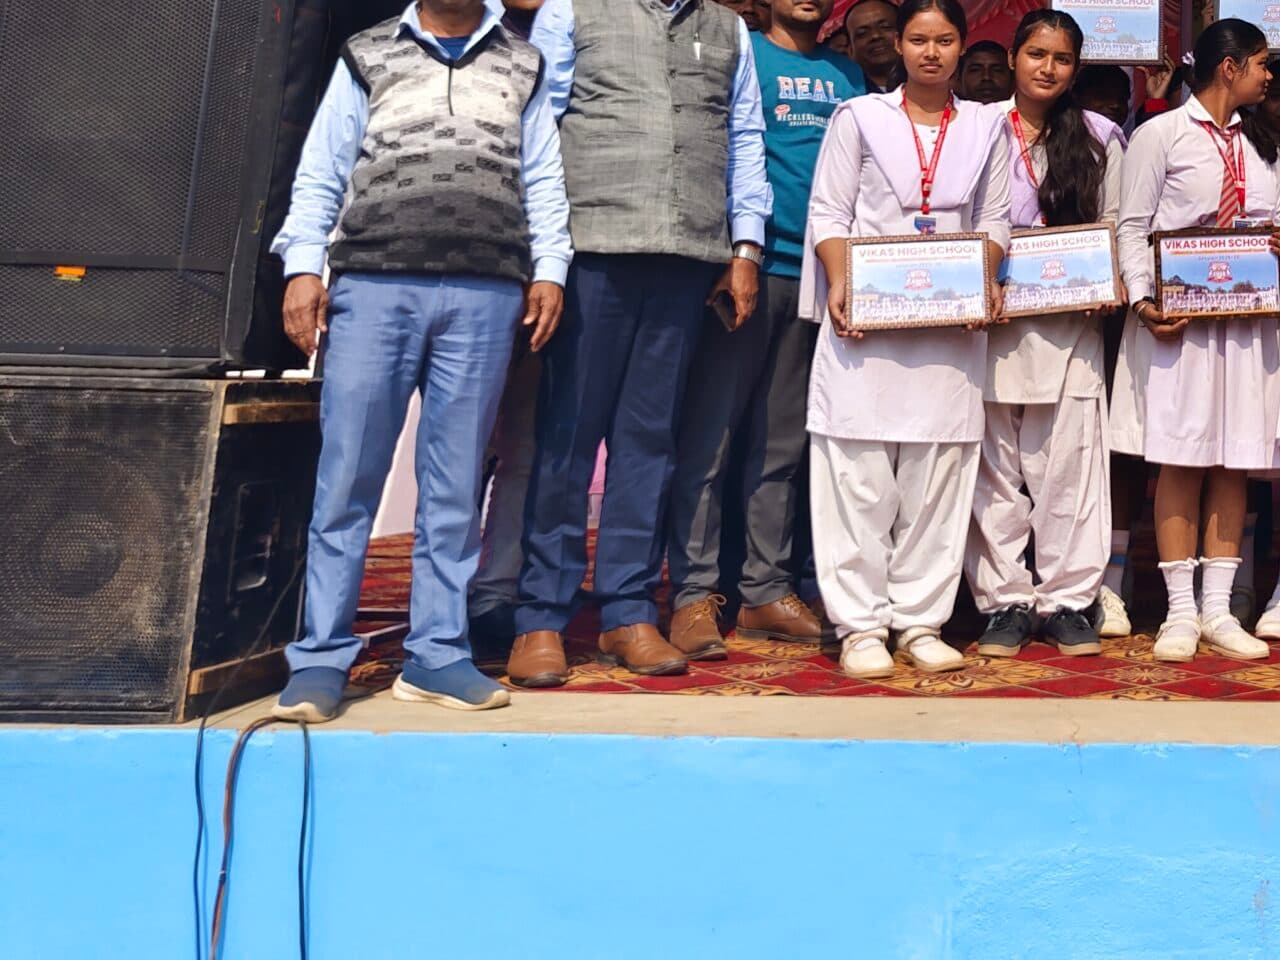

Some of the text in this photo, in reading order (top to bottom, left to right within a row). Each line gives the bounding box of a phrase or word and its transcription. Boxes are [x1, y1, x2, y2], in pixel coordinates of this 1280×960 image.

[776, 75, 842, 104] REAL
[1009, 241, 1030, 251] KAS
[1031, 239, 1059, 249] HIGH
[1061, 234, 1106, 246] SCHOOL
[1164, 240, 1198, 249] VIKAS
[1200, 239, 1226, 248] HIGH
[859, 244, 978, 257] VIKAS HIGH SCHOOL
